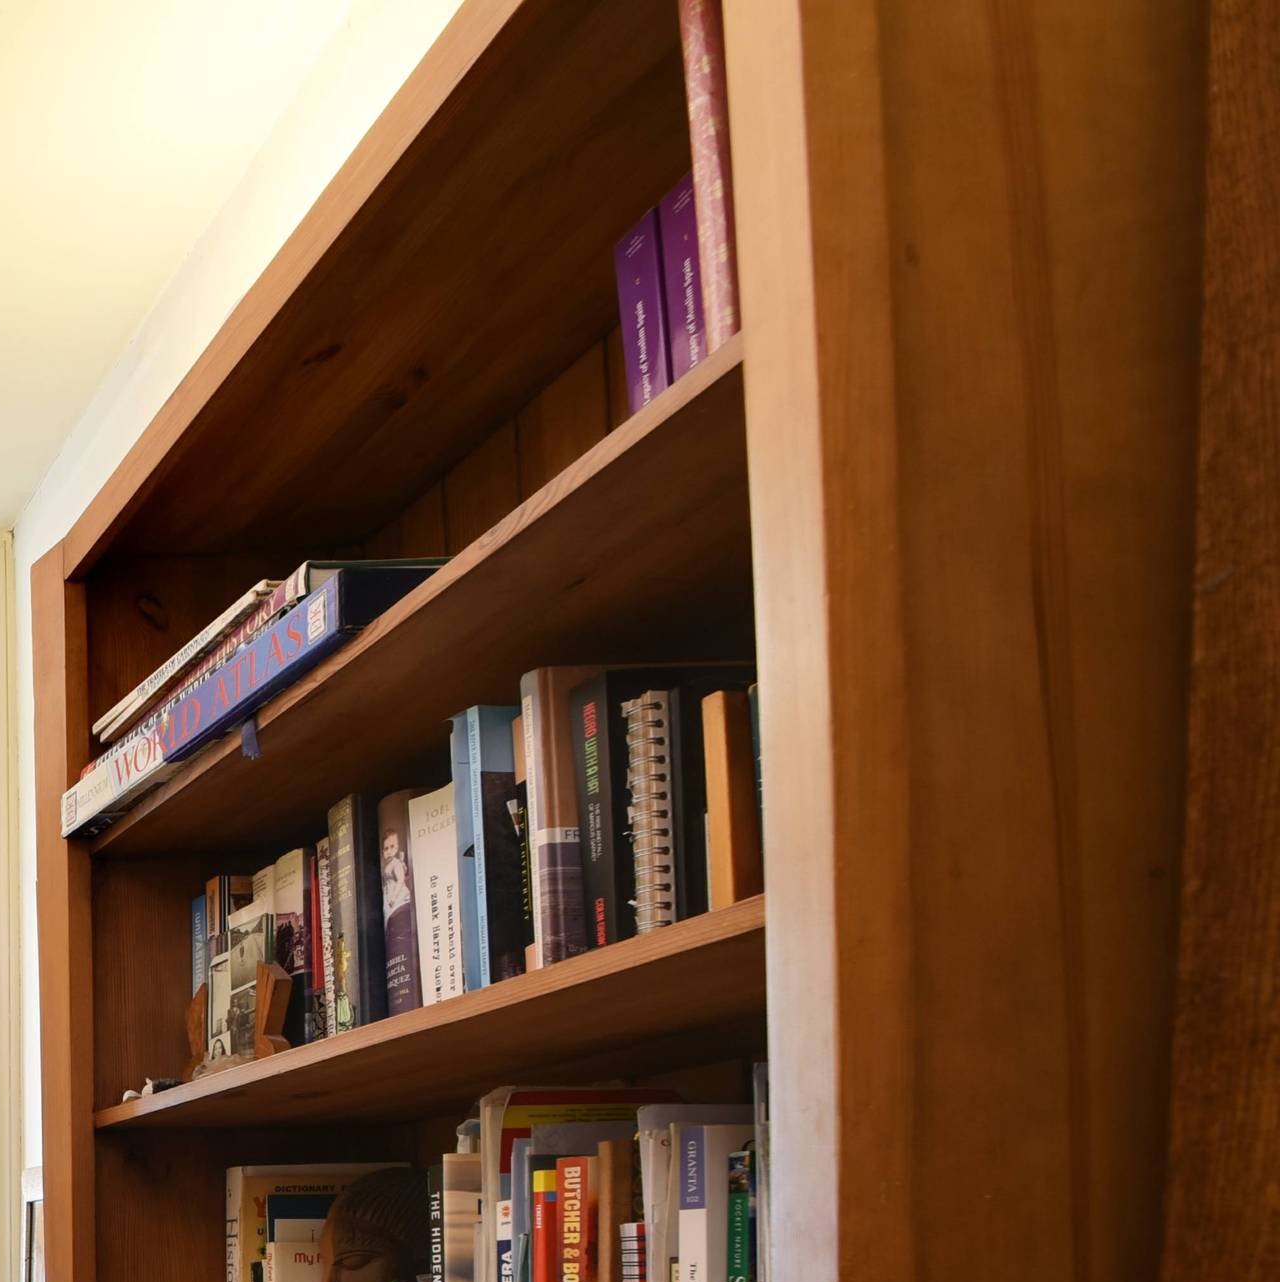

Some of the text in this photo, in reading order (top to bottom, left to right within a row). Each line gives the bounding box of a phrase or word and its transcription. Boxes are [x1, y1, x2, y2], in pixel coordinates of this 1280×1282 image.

[637, 327, 648, 363] Muslim
[114, 698, 200, 785] WORLD
[210, 613, 303, 718] ATLAS
[583, 702, 600, 797] NEGRO WITH A HAT
[430, 894, 438, 921] zaak
[432, 926, 441, 961] Harry
[687, 1140, 698, 1193] GRANTA
[274, 1184, 335, 1193] DICTIONARY
[430, 1191, 440, 1221] THE
[563, 1165, 582, 1244] BUTCHER
[734, 1199, 743, 1269] POCKET NATURE
[293, 1251, 314, 1266] My
[563, 1247, 580, 1259] &
[689, 1262, 698, 1281] The
